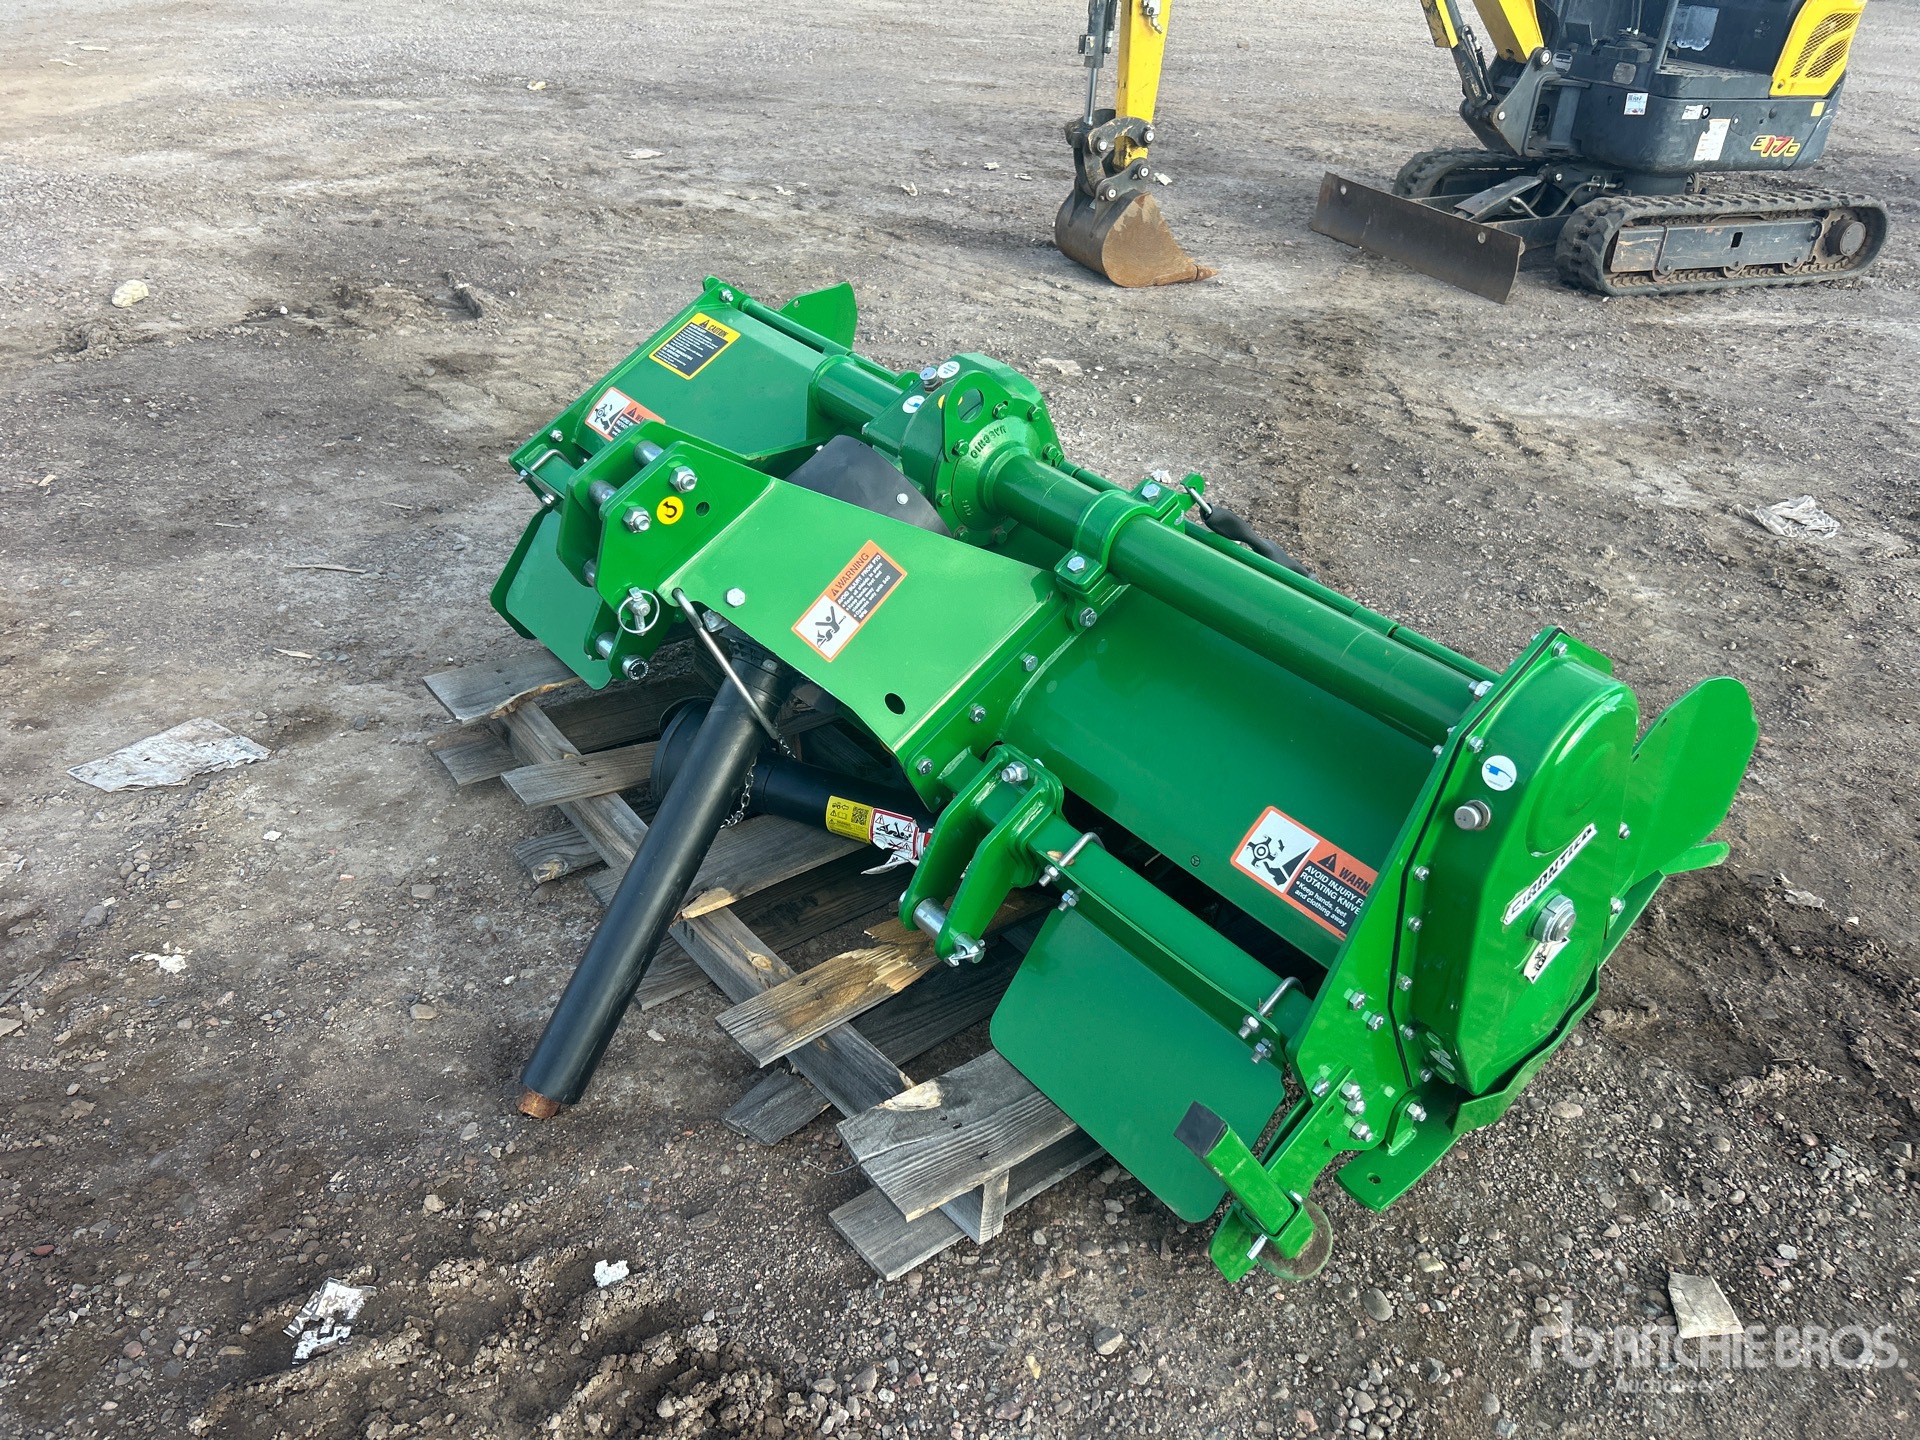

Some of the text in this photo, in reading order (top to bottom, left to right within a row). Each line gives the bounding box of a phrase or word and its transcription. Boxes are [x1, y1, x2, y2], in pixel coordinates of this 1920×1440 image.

[835, 551, 869, 589] WARNING
[871, 554, 881, 564] PTO
[1299, 871, 1338, 899] ROTATING
[1336, 895, 1361, 915] KNIVE
[1304, 864, 1357, 901] AVOID INJURY
[1337, 866, 1373, 894] WARN
[1294, 888, 1347, 928] and clothing away
[1297, 882, 1347, 917] Keep hands, feet
